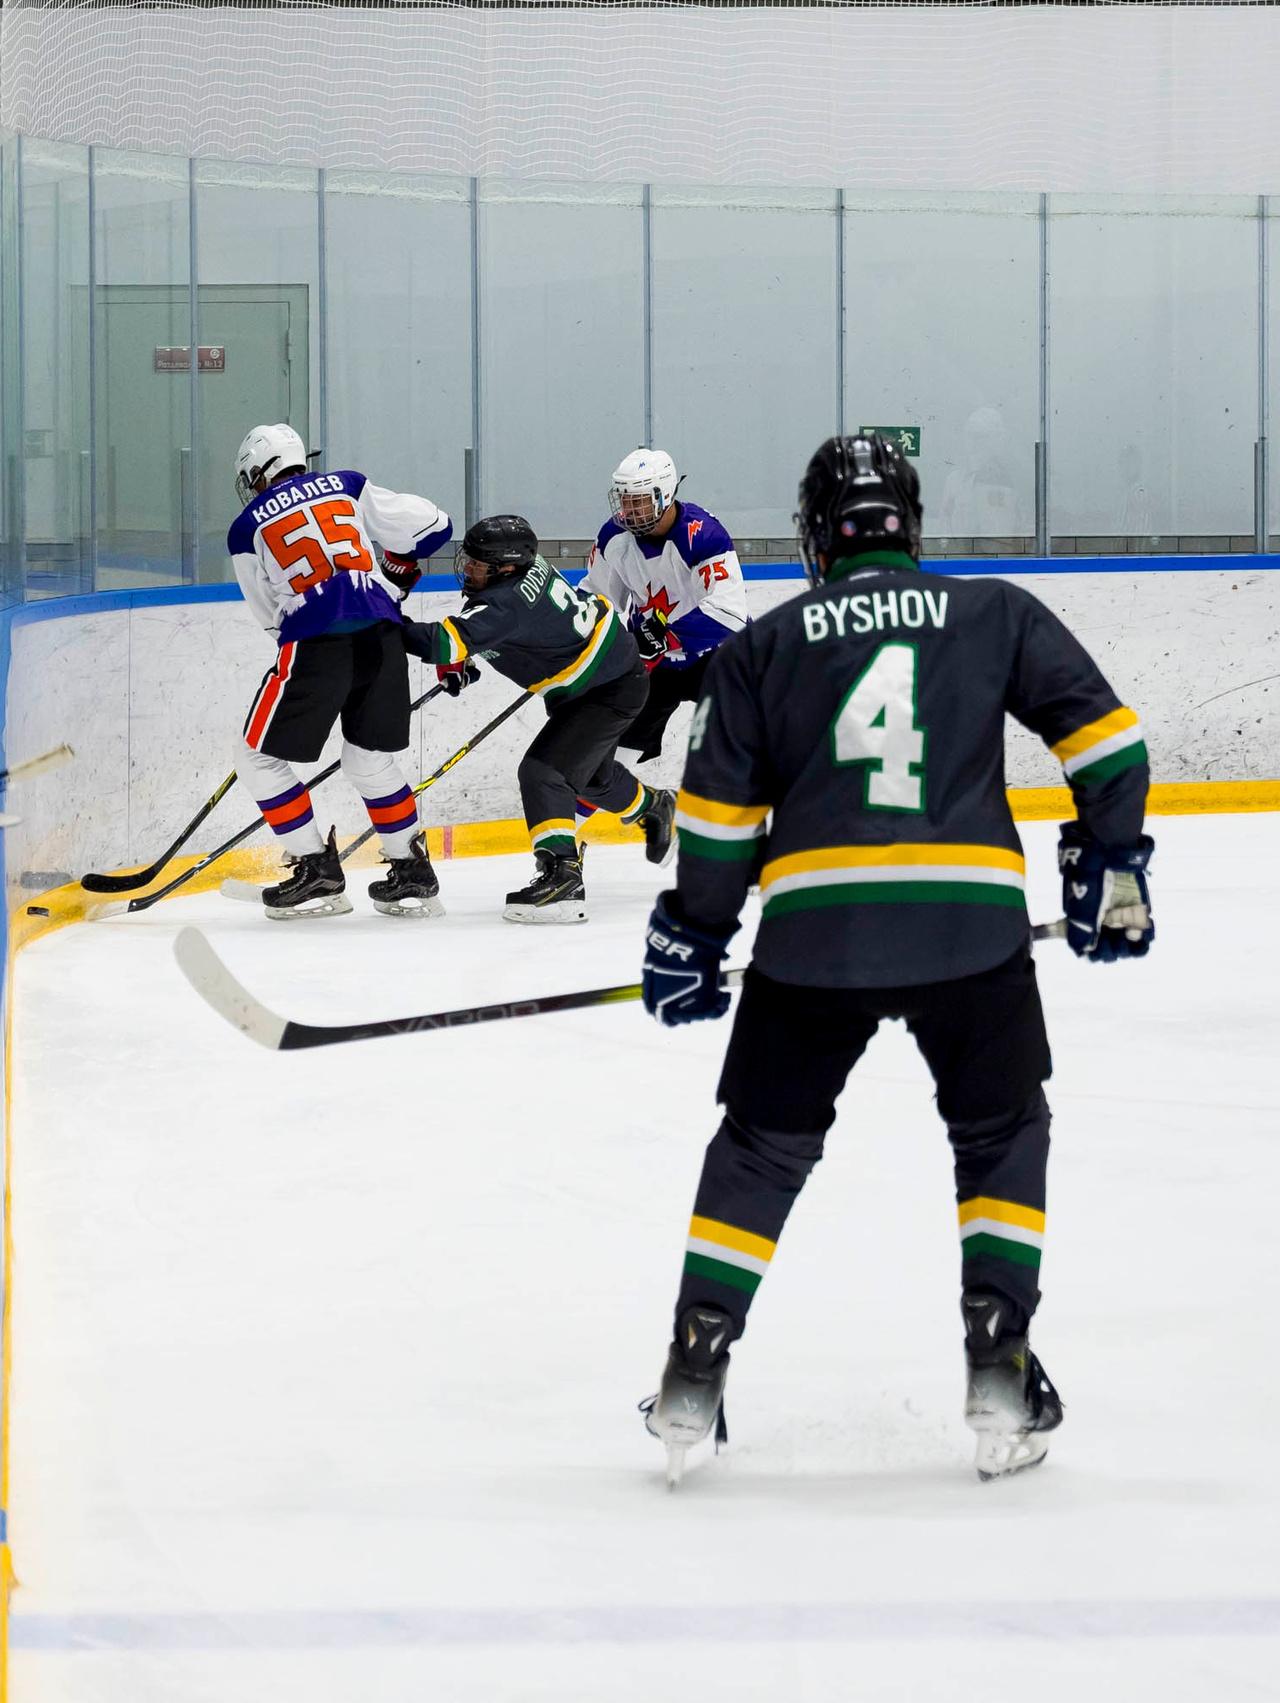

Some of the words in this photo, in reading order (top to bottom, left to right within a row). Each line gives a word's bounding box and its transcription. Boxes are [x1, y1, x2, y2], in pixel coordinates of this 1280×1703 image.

[252, 475, 344, 523] КОВАЛЕВ
[261, 499, 373, 595] 55
[698, 558, 729, 592] 75
[803, 589, 949, 642] BYSHOV
[830, 641, 928, 813] 4
